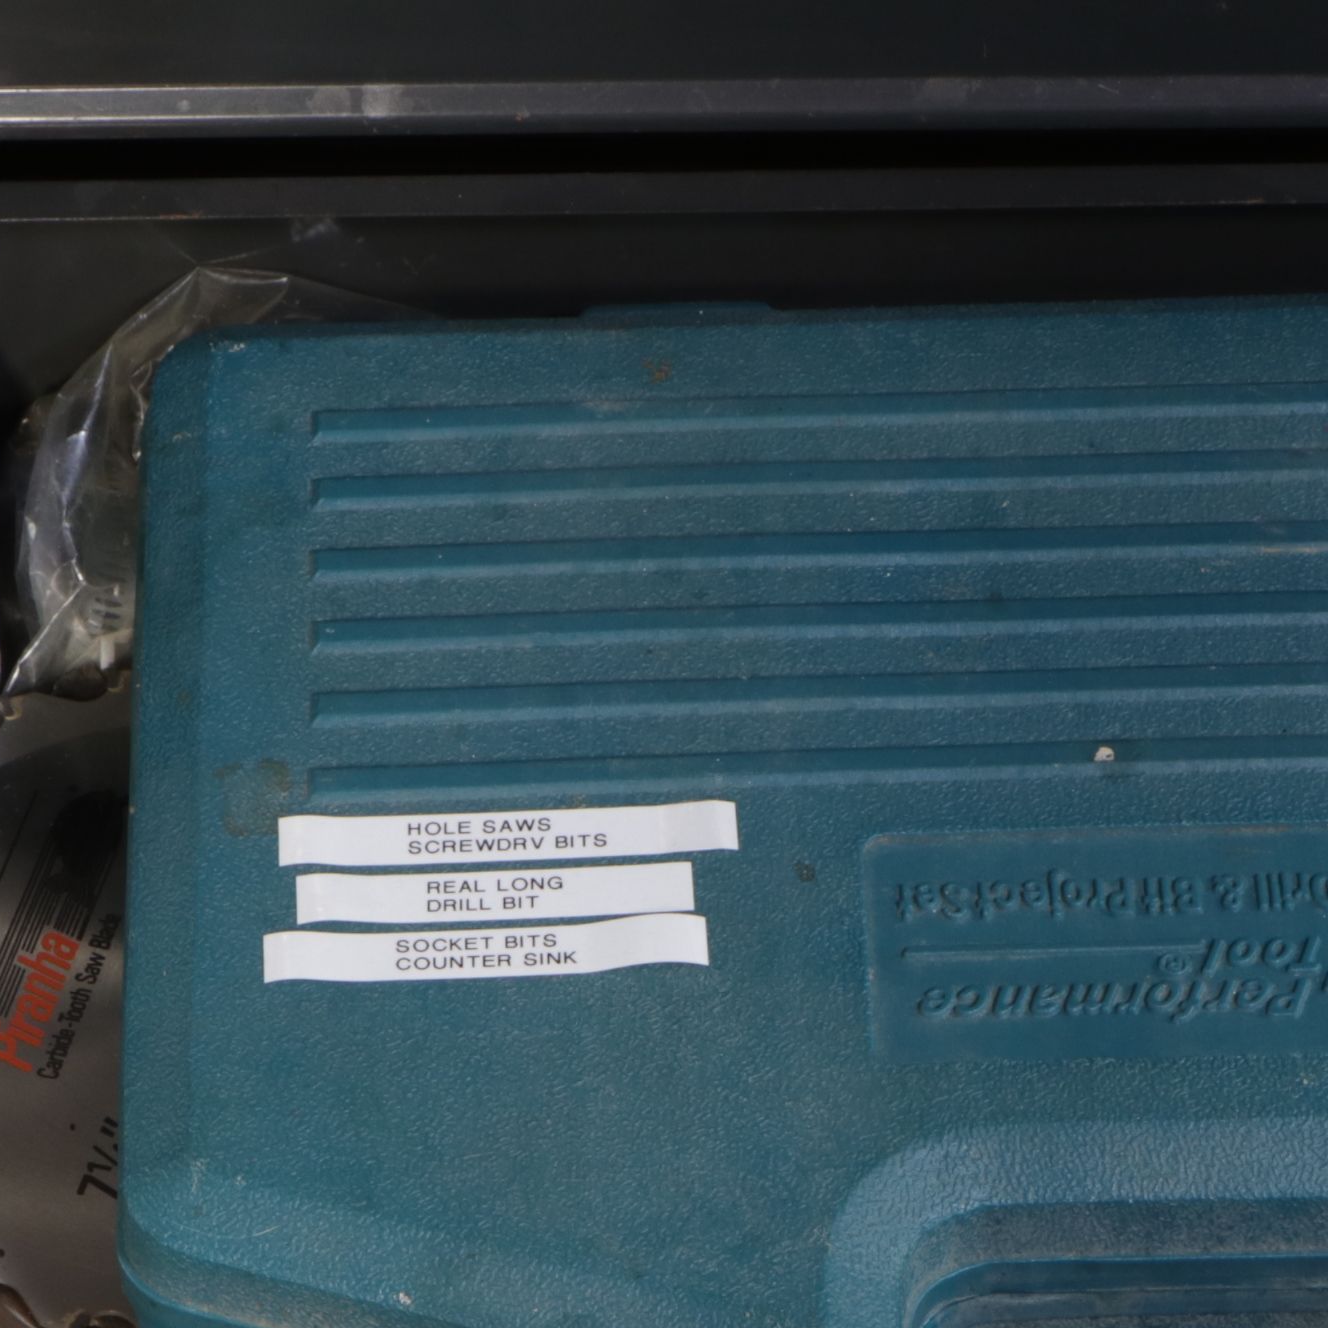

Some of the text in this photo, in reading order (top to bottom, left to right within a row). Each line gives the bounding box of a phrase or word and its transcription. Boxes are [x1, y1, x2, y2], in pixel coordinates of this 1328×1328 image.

[407, 818, 553, 836] HOLE SAWS
[407, 833, 609, 855] SCREWDRV BITS
[426, 876, 564, 895] REAL LONG
[895, 877, 974, 927] Set
[976, 869, 1132, 922] Project
[1140, 873, 1207, 918] Bit
[1217, 873, 1248, 913] &
[427, 894, 540, 913] DRILL BIT
[88, 912, 122, 951] Blade
[395, 934, 558, 954] SOCKET BITS
[75, 953, 106, 985] Saw
[395, 950, 578, 971] COUNTER SINK
[1201, 934, 1324, 978] Tool
[915, 974, 1313, 1023] Performance
